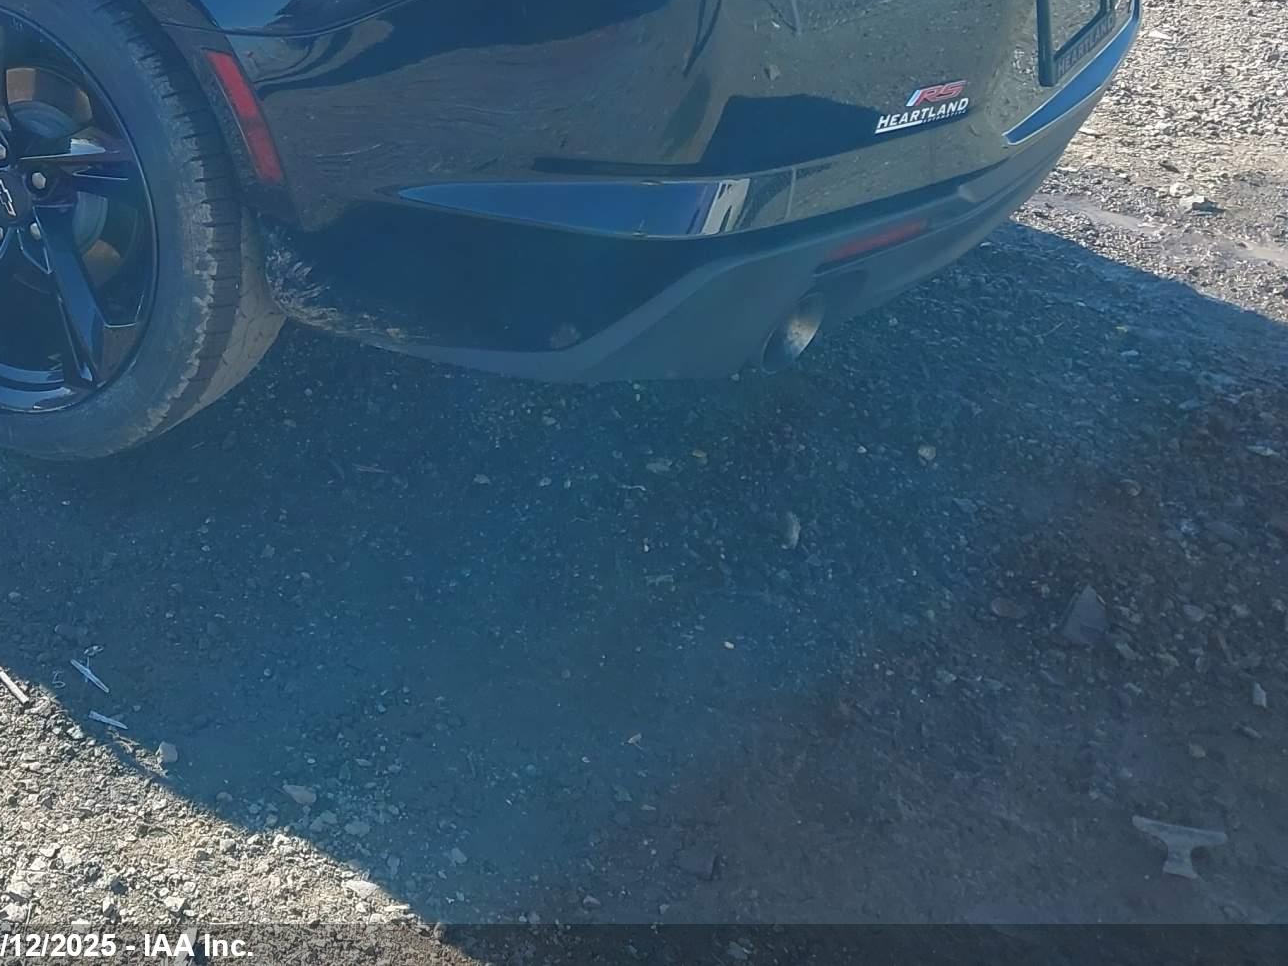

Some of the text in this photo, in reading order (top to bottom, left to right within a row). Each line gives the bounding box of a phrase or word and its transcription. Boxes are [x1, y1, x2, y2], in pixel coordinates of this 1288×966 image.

[1057, 14, 1115, 77] HEARTLAND
[914, 80, 968, 106] RS
[876, 97, 969, 129] HEARTLAND
